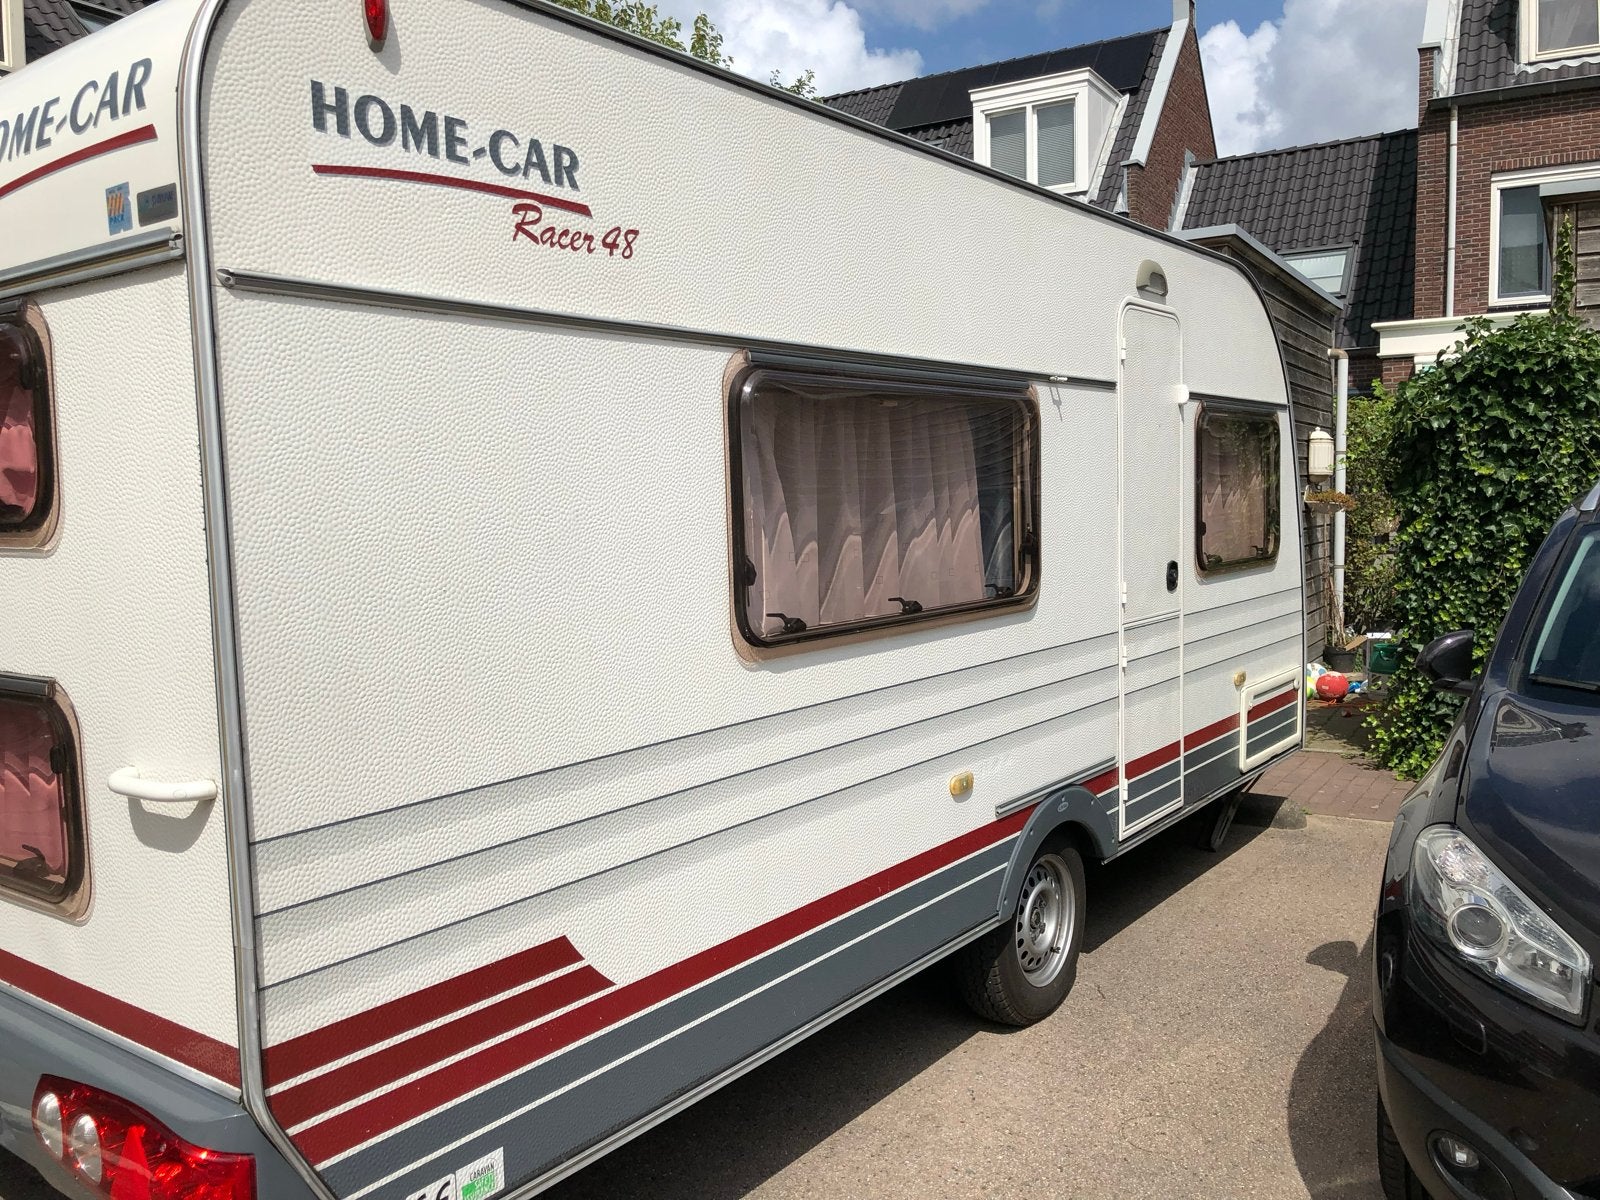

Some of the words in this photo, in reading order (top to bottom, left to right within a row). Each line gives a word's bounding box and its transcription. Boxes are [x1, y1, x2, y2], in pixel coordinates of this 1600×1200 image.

[310, 79, 580, 192] HOME-CAR
[511, 202, 596, 255] Racer
[601, 226, 640, 260] 48
[469, 1161, 495, 1182] CARAVAN
